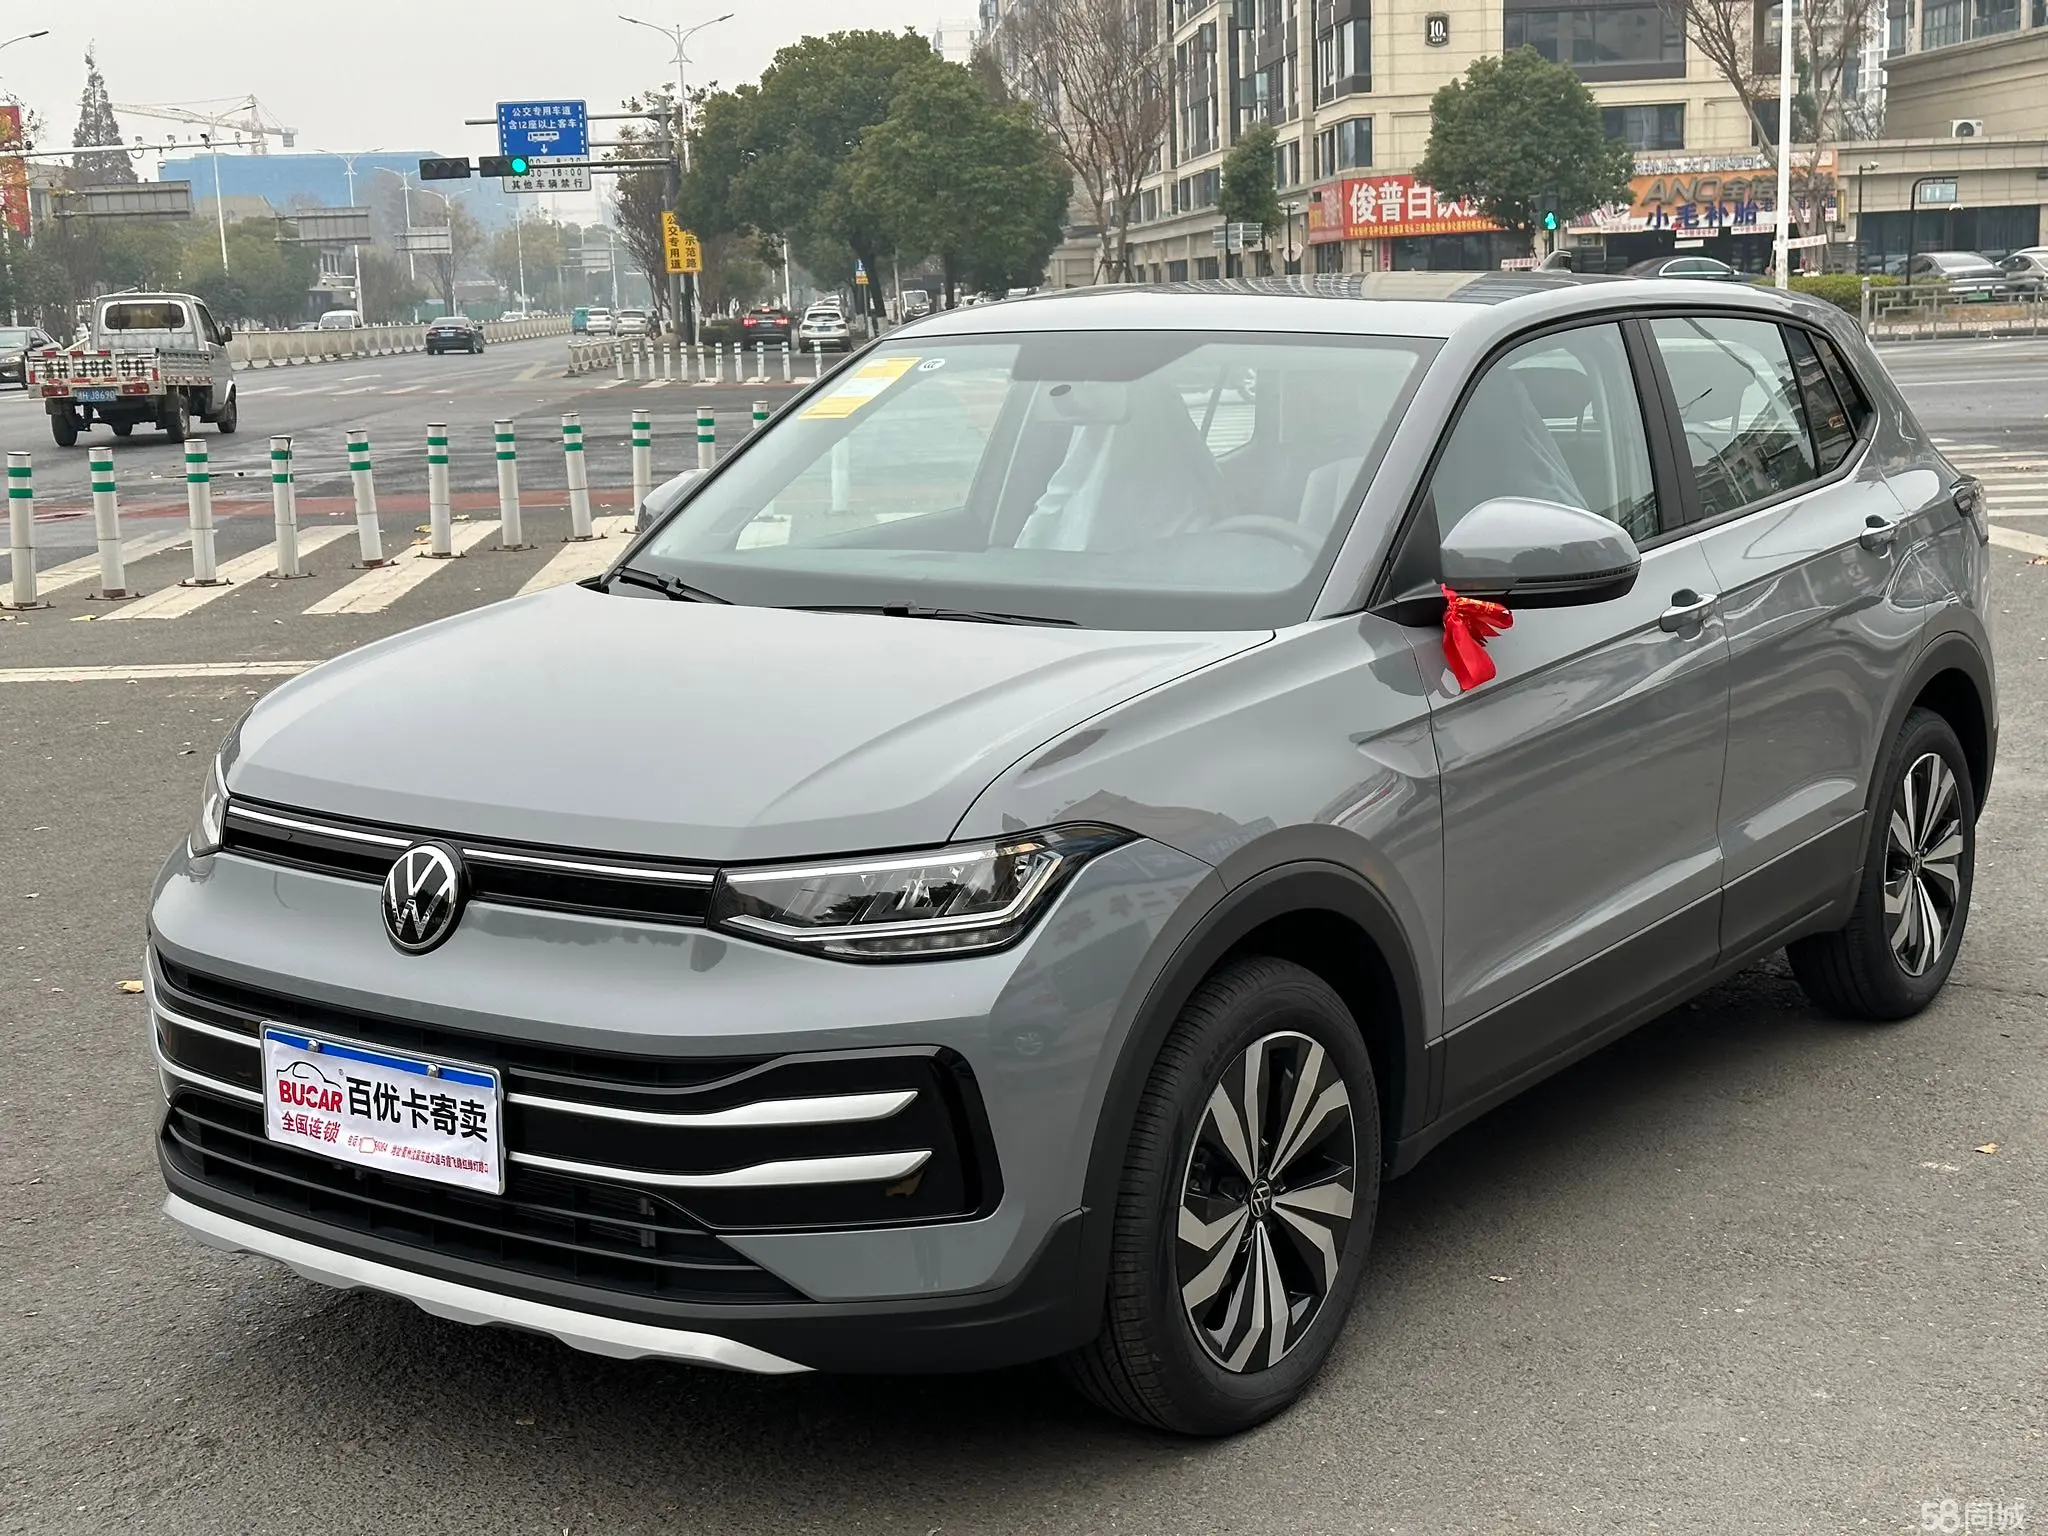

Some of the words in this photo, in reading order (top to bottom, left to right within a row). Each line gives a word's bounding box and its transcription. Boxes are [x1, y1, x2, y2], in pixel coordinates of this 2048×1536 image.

[508, 118, 577, 130] 含12座以上客车
[512, 106, 571, 117] 公交专用车道
[512, 179, 583, 190] 其他车辆禁行
[1646, 199, 1759, 230] 小毛补胎
[667, 215, 681, 269] 公交专用道
[278, 1079, 344, 1114] BUCAR
[346, 1076, 488, 1143] 百优卡寄卖
[281, 1110, 341, 1144] 全国连锁
